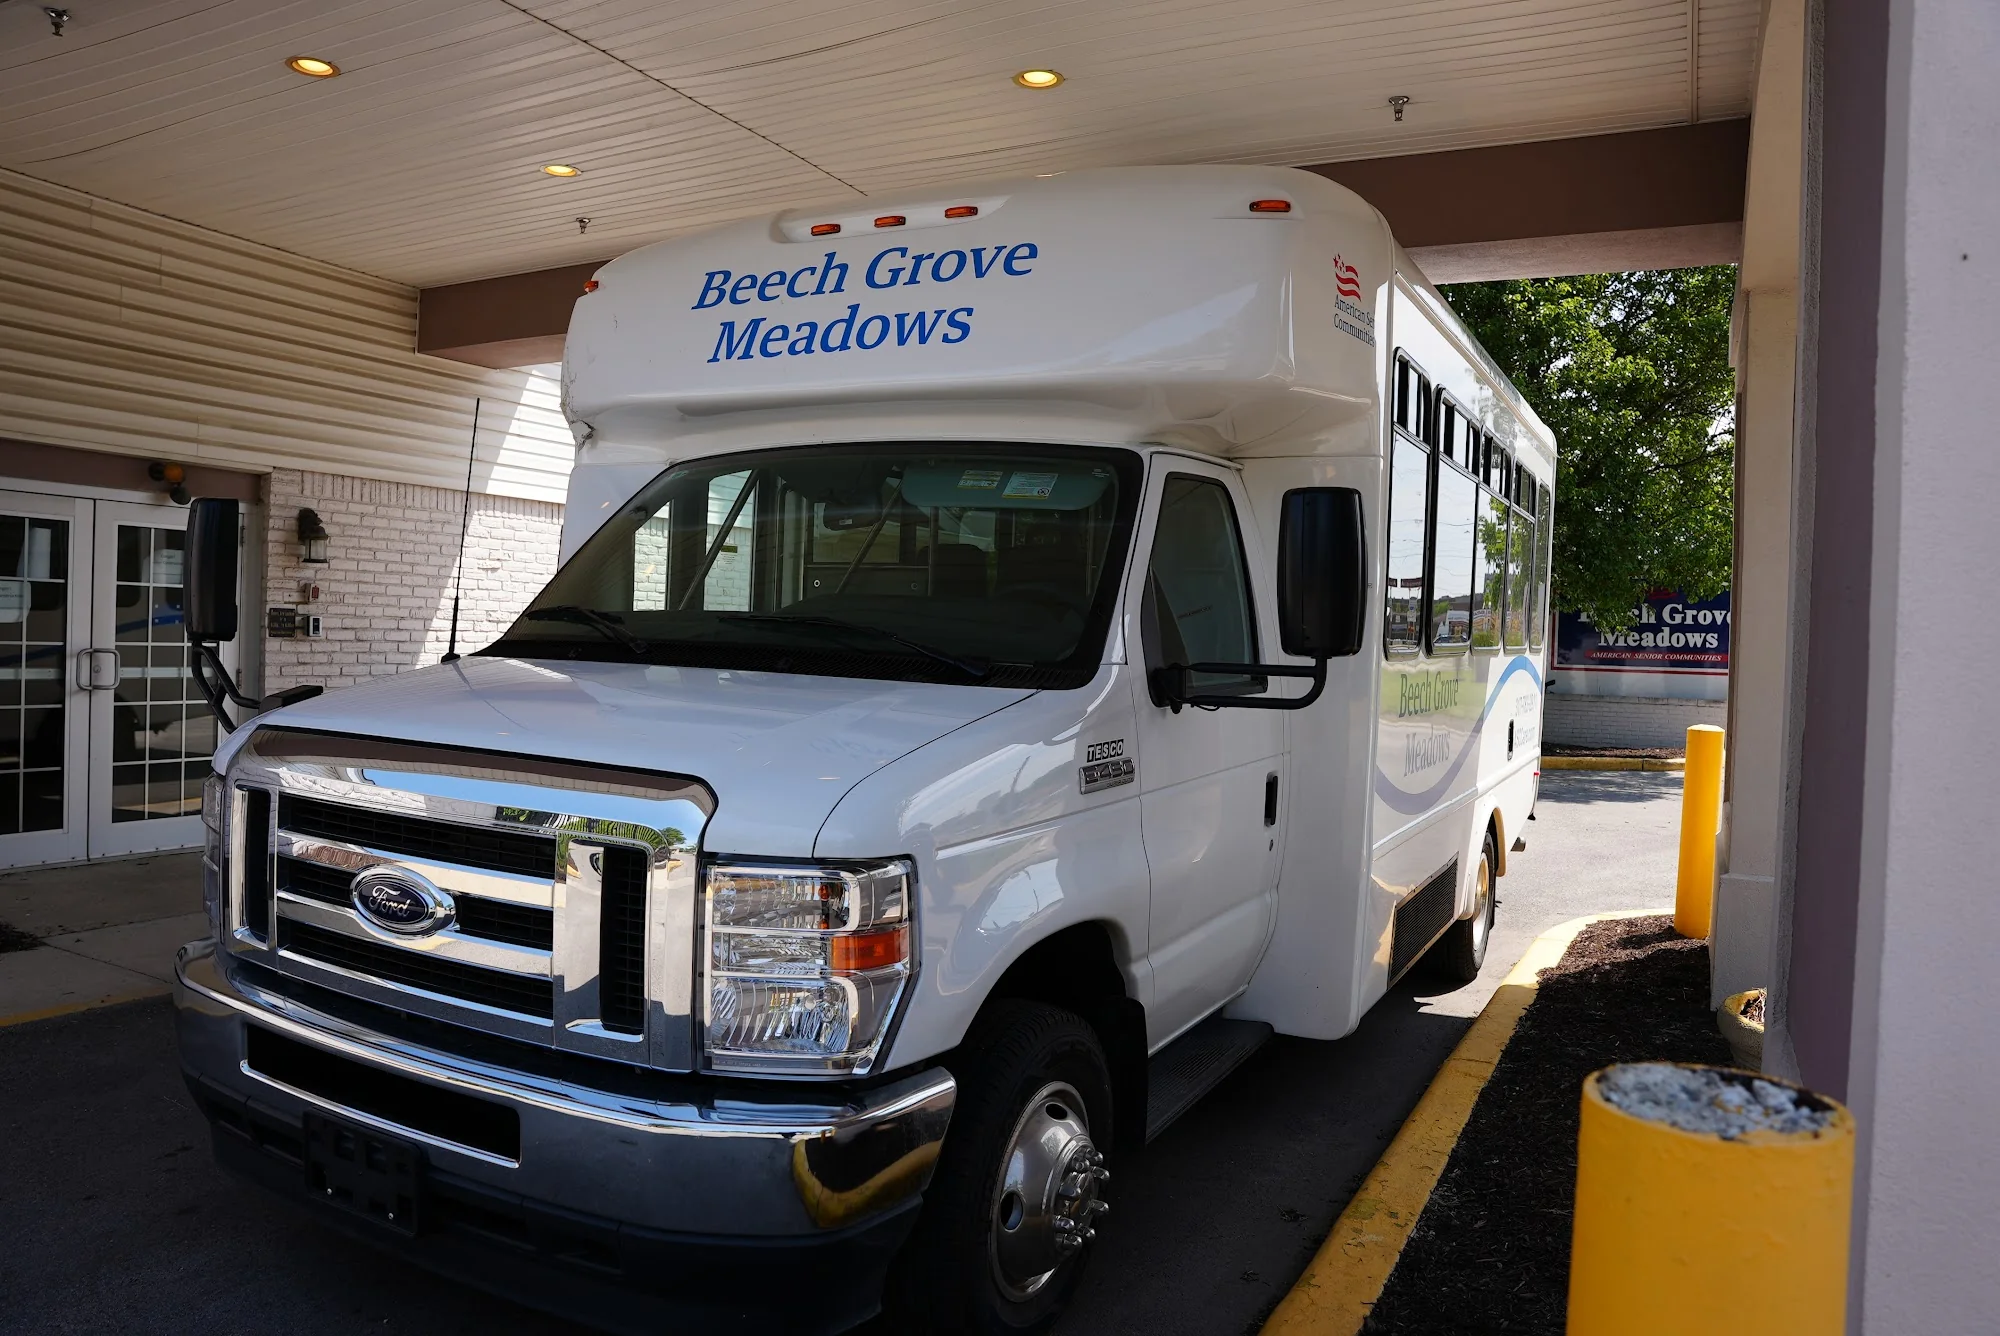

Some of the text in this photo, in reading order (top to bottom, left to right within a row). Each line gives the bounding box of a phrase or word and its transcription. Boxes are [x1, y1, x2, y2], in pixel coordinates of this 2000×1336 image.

[691, 242, 1039, 310] Beech Grove
[1334, 294, 1365, 323] American
[707, 303, 974, 363] Meadows
[1333, 313, 1376, 347] Communities
[1662, 603, 1731, 625] Grov
[1590, 651, 1632, 659] AMERICAN
[1664, 653, 1722, 661] COMMUNITIES
[1399, 670, 1459, 718] Beech Grove
[1087, 739, 1124, 763] TESCO
[1403, 724, 1451, 777] Meadows
[368, 885, 411, 917] Ford
